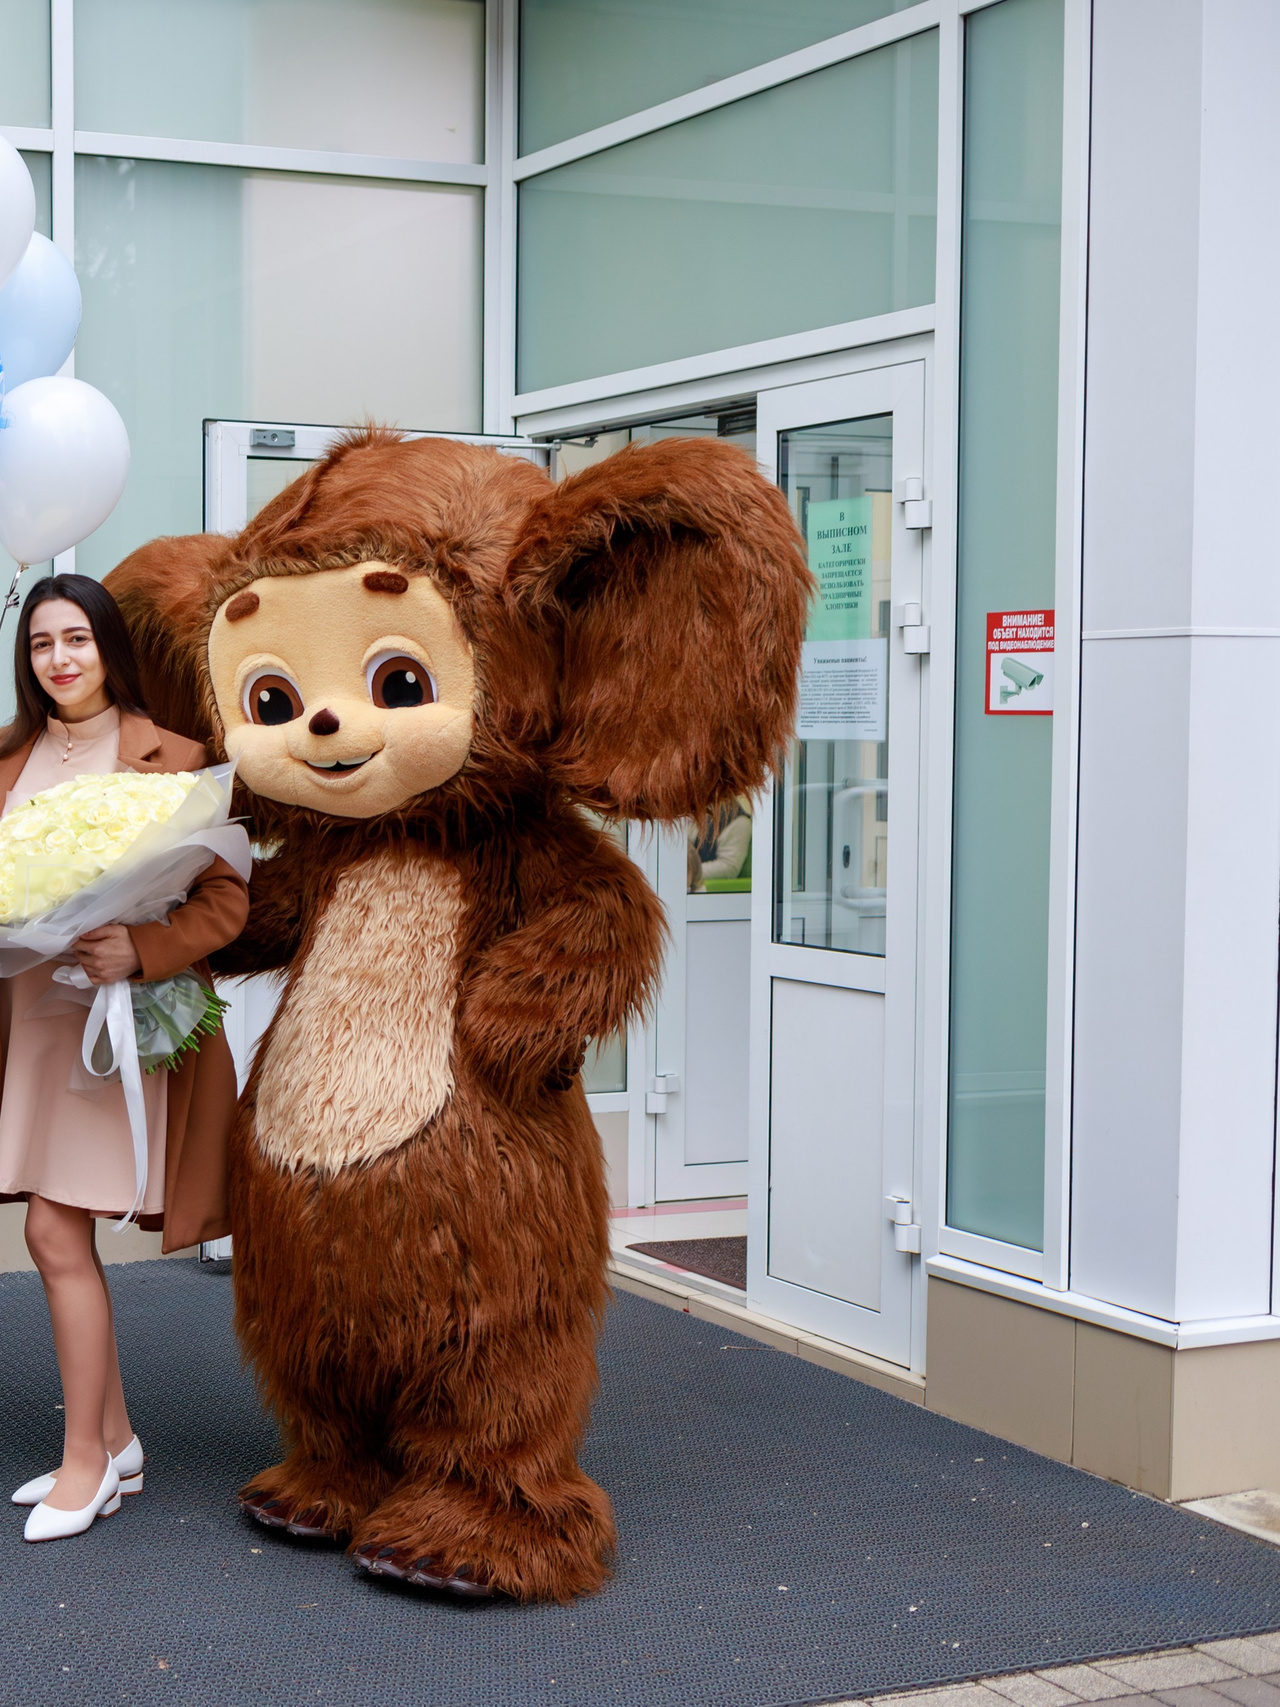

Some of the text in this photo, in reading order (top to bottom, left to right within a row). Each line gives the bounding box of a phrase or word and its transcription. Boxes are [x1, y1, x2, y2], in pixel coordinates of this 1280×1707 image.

[839, 512, 845, 521] В
[817, 525, 867, 540] ВЫПИСНОМ
[831, 543, 852, 554] ЗАЛЕ
[818, 558, 866, 569] КАТЕГОРИЧЕСКИ
[822, 569, 863, 579] ЗАПРЕЩАЕТСЯ
[820, 580, 864, 590] ИСПОЛЬЗОВАТЬ
[825, 602, 858, 611] ХЛОПУШКИ
[1002, 614, 1044, 627] ВНИМАНИЕ!
[993, 626, 1054, 639] ОБЪЕКТ НАХОДИТСЯ
[988, 639, 1054, 651] ПОД ВИДЕОНАБЛЮДЕНИЕ
